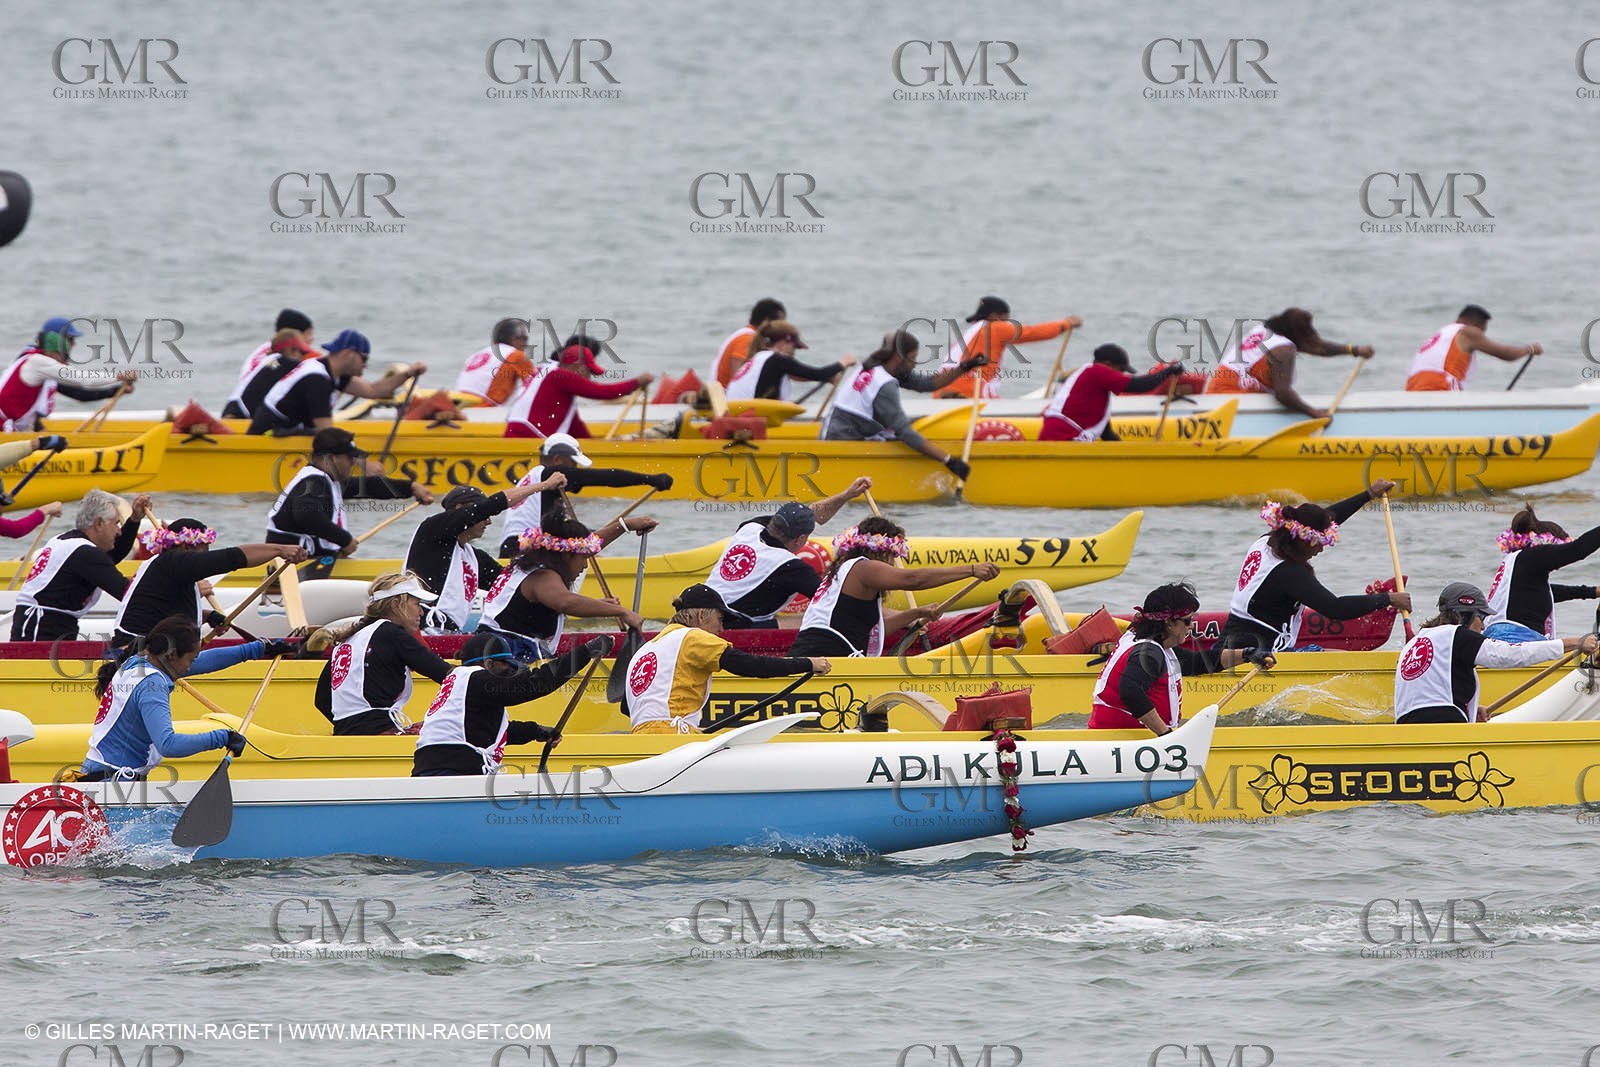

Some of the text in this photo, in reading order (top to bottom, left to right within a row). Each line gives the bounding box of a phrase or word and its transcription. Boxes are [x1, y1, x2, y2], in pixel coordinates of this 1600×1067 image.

[1177, 419, 1222, 439] 107X
[90, 445, 144, 473] 117
[1300, 443, 1364, 455] MANA
[1483, 435, 1552, 460] 109
[401, 458, 530, 486] SFOCC
[927, 549, 980, 564] KUPA'A
[984, 548, 1009, 562] KAI
[1015, 538, 1071, 567] 59
[1308, 613, 1344, 636] 98
[700, 700, 818, 721] FOCC
[866, 744, 1189, 783] ADI KULA 103
[1310, 769, 1454, 794] SFOCC
[22, 809, 86, 849] AC
